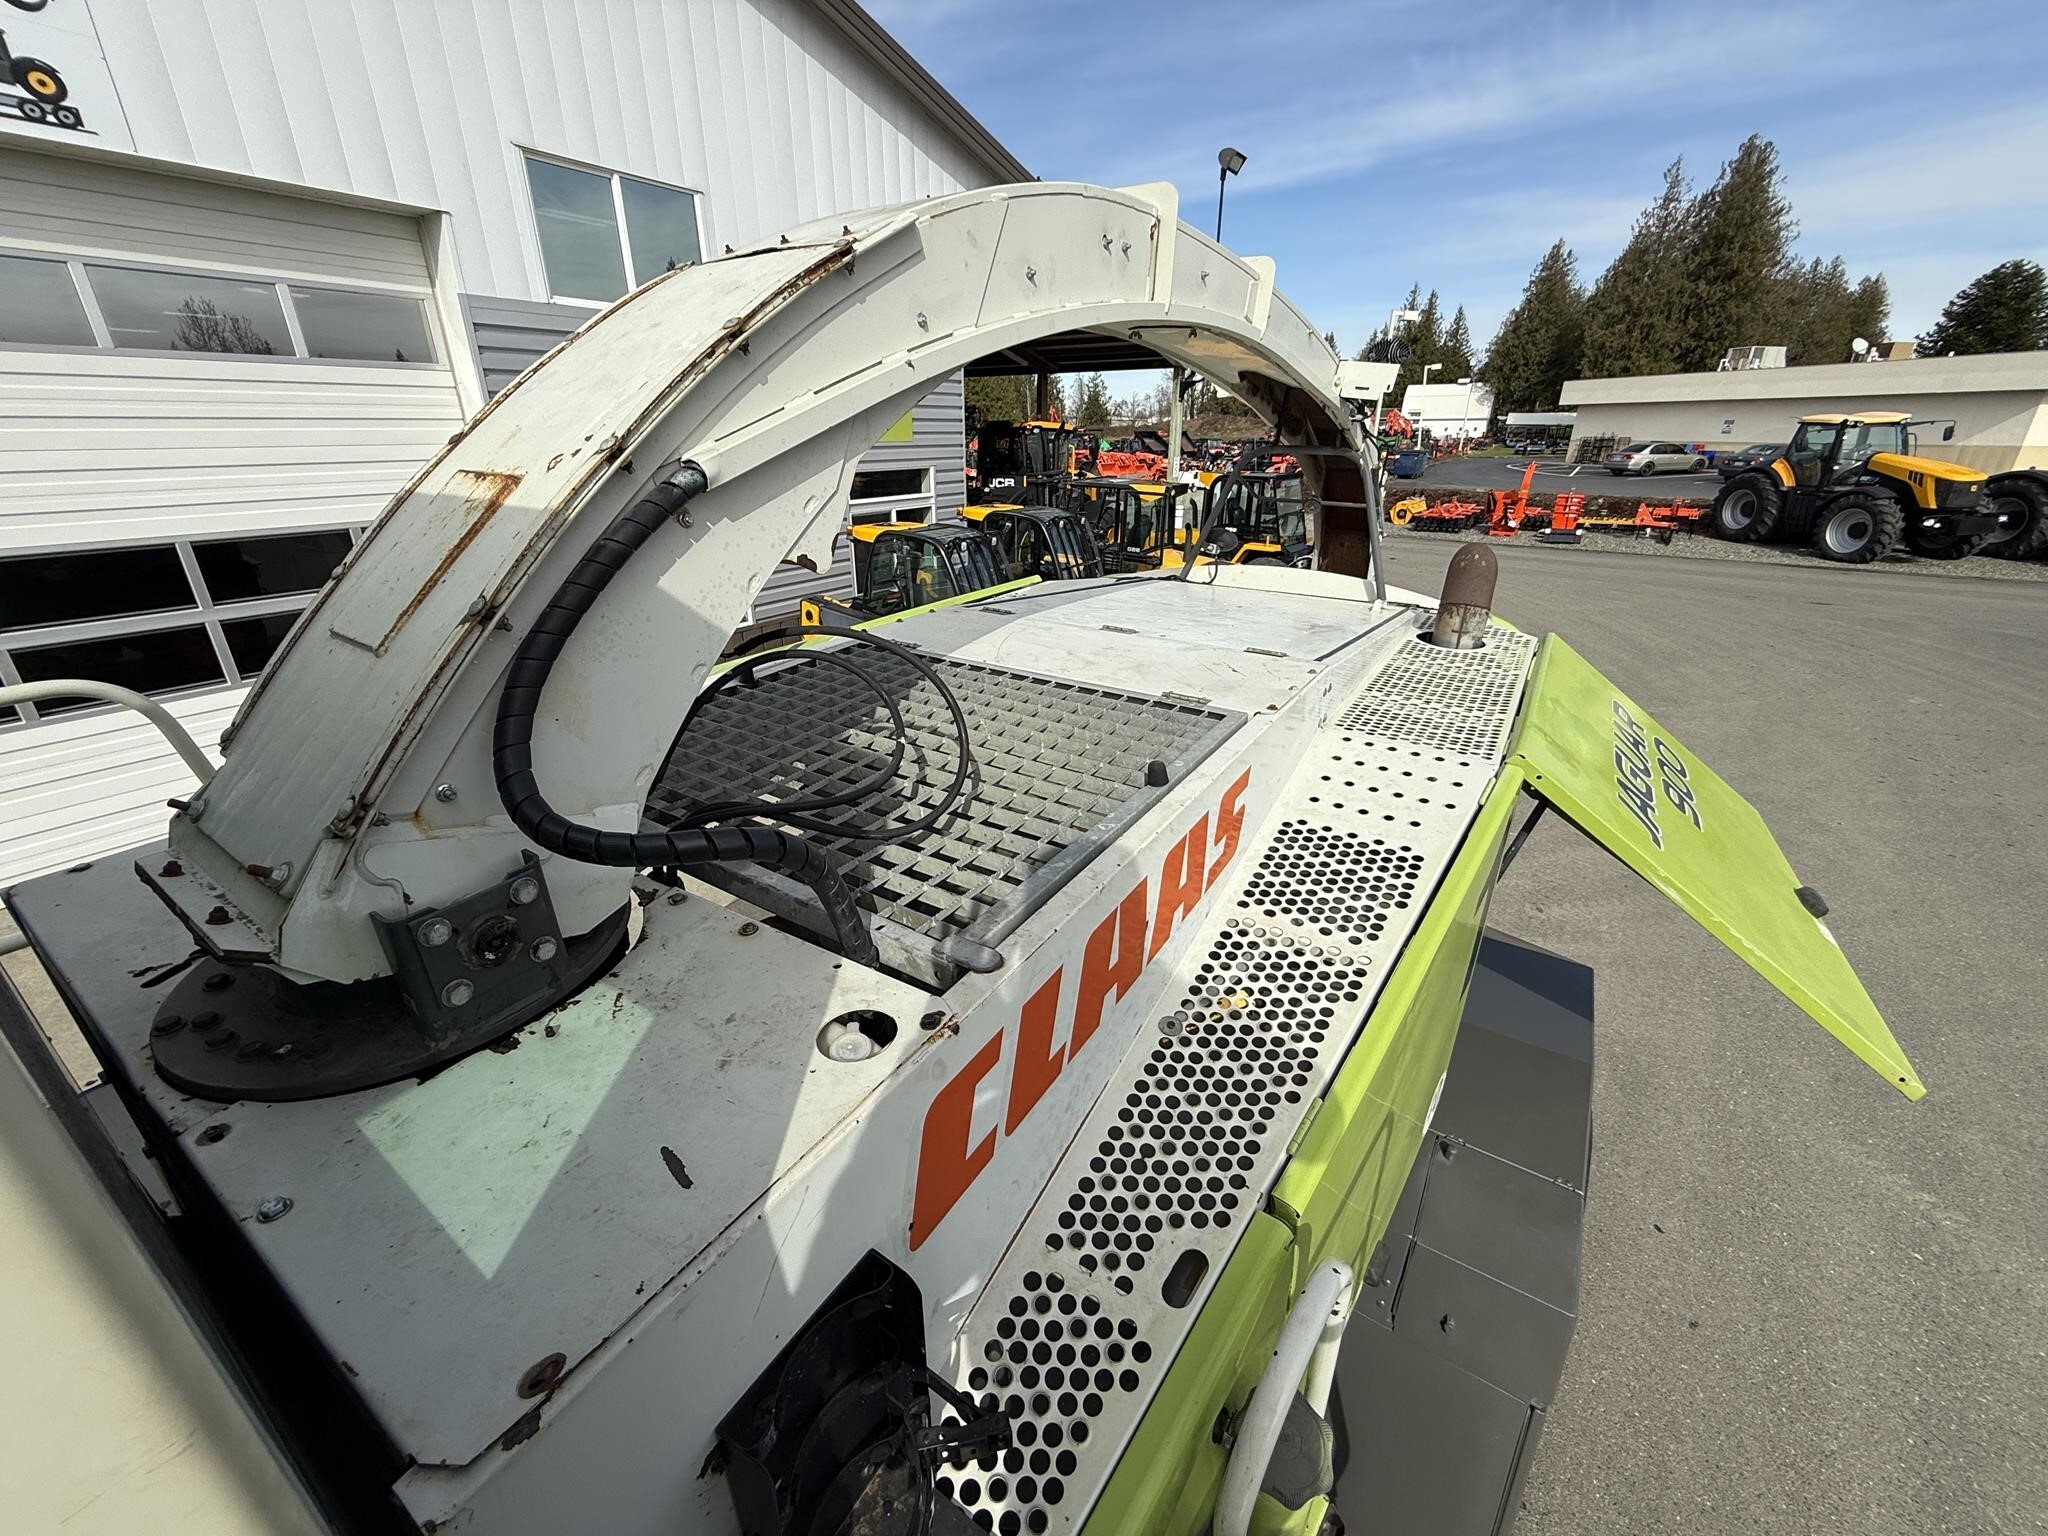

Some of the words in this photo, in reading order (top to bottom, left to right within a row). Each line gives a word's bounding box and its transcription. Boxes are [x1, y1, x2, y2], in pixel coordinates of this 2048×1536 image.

[1612, 699, 1664, 851] JAGUAR
[1653, 736, 1704, 832] 900
[908, 765, 1251, 1252] CLAAS
